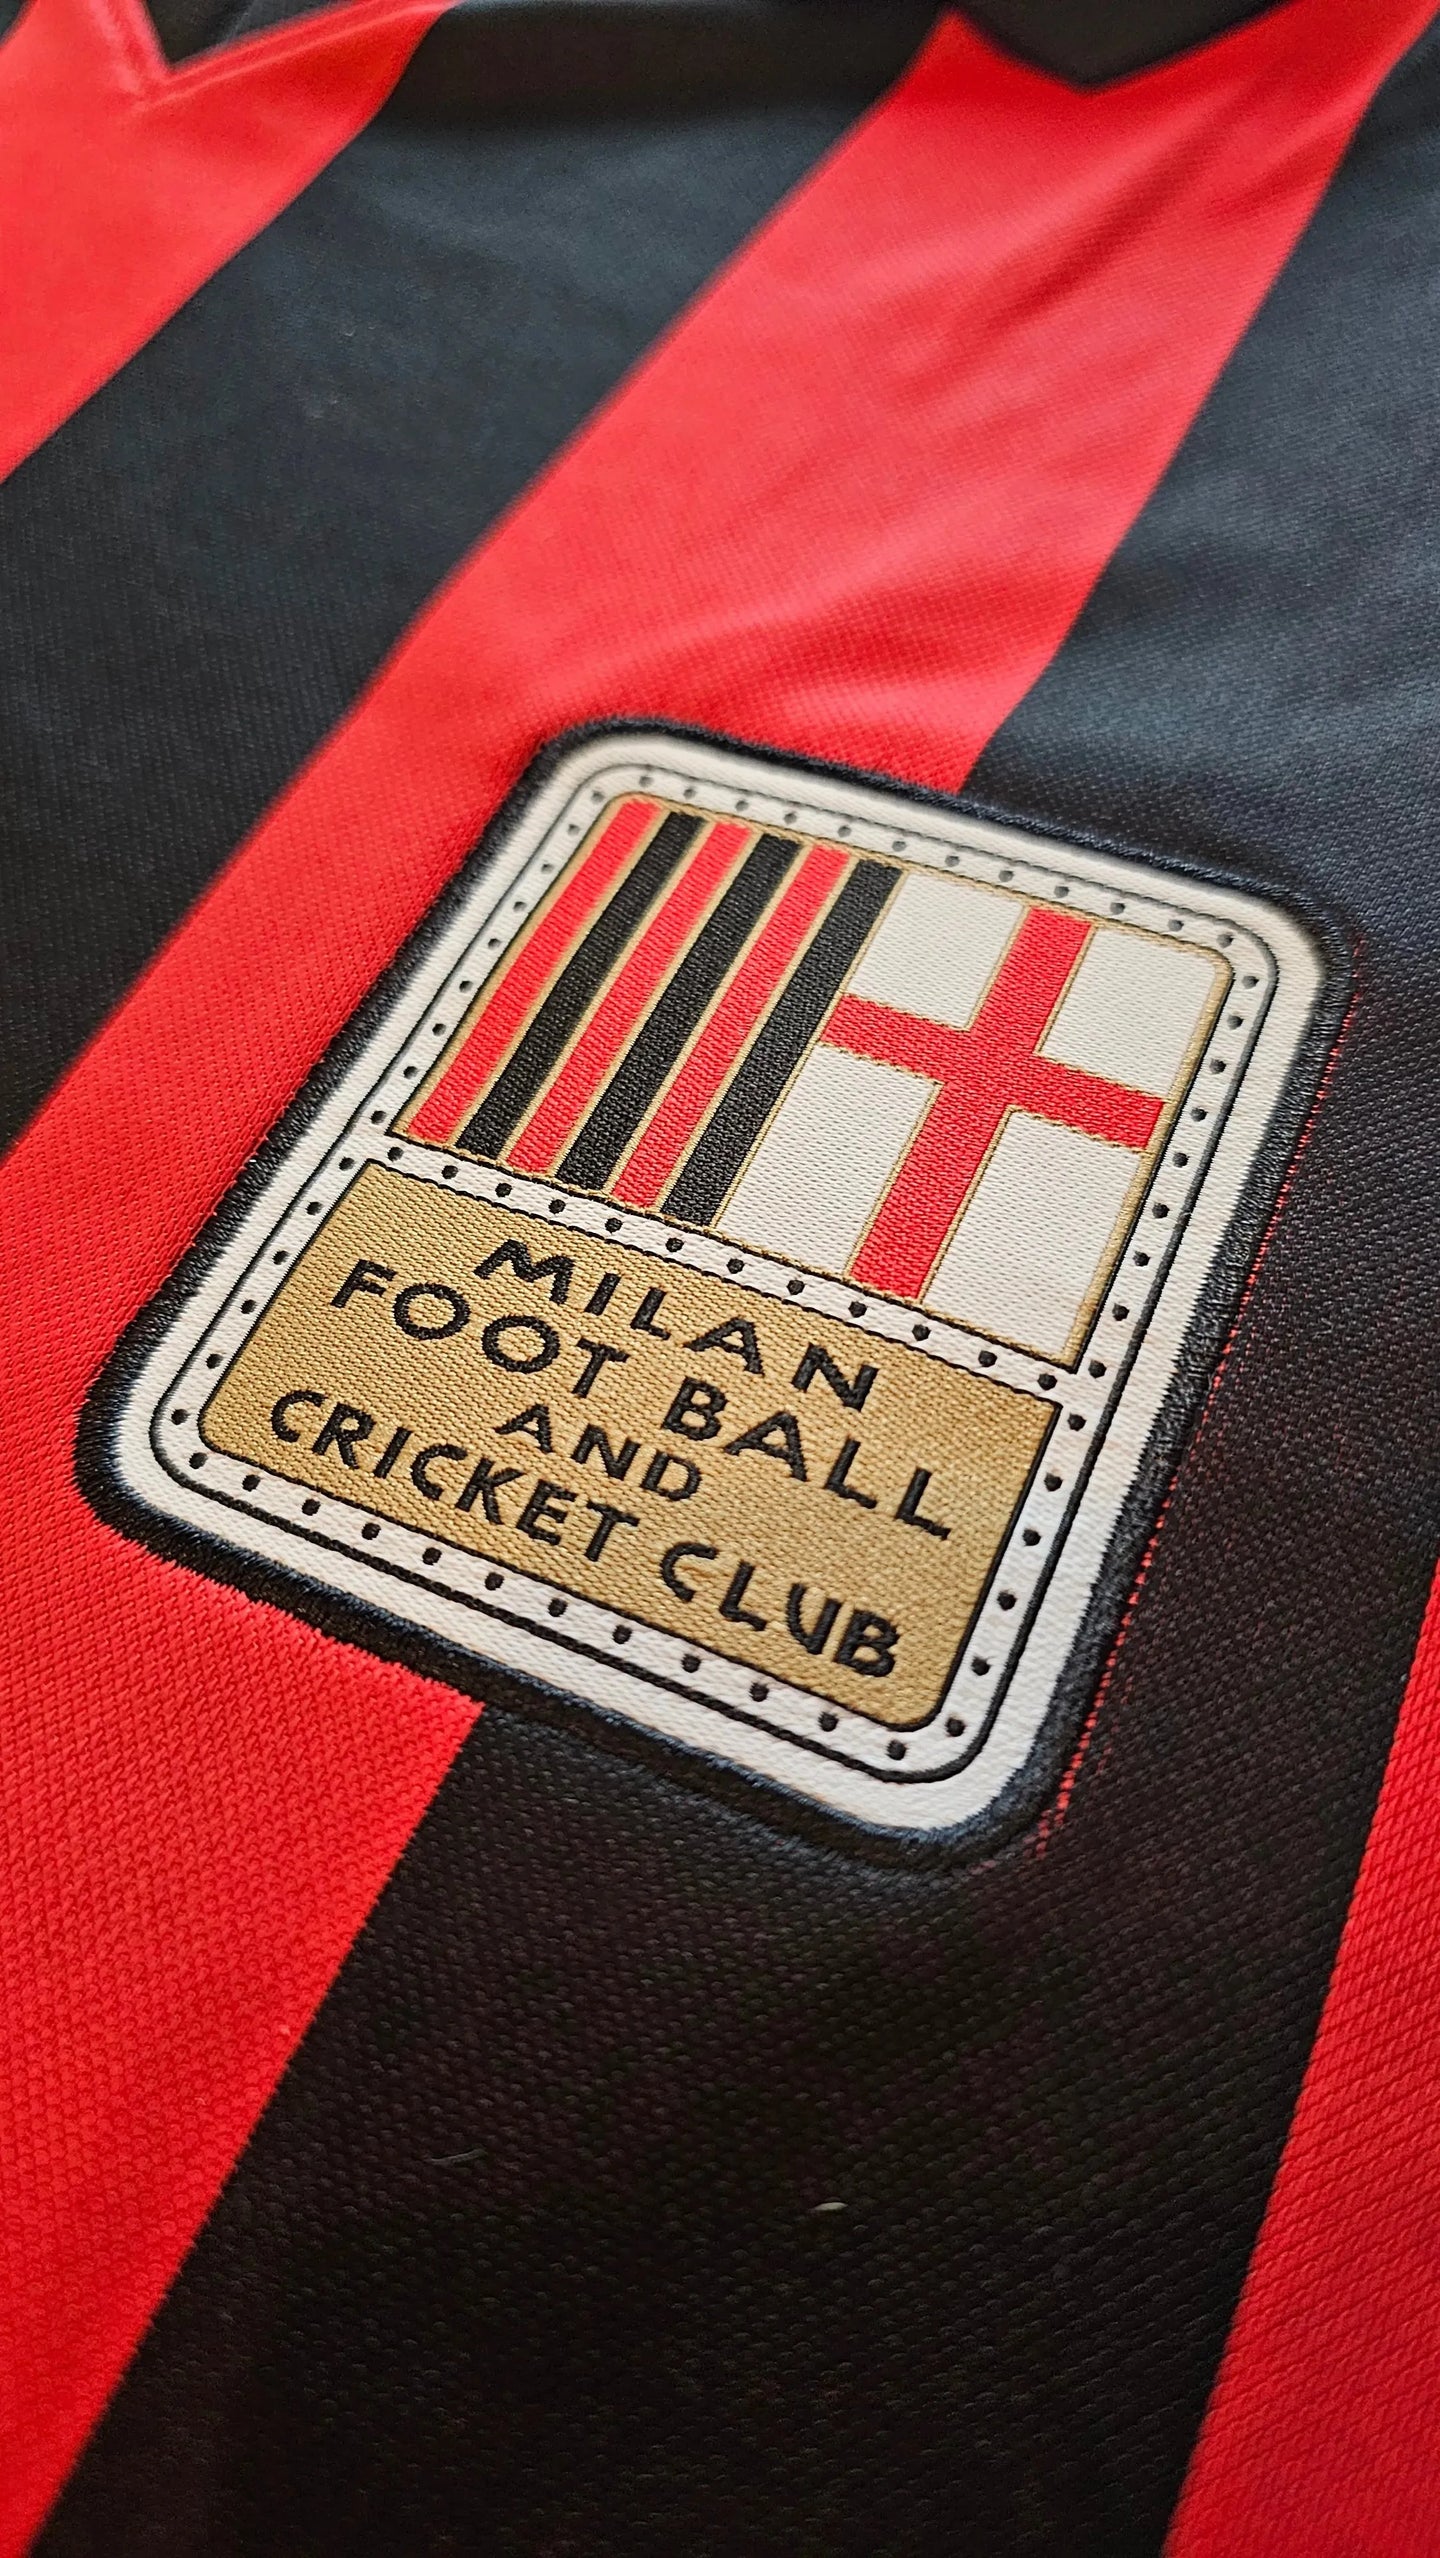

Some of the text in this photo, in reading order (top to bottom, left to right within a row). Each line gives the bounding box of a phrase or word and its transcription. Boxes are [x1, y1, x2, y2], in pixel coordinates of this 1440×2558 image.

[329, 1258, 953, 1540] FOOT BALL
[473, 1238, 880, 1414] MILAN
[270, 1390, 902, 1678] CRICKET CLUB
[495, 1404, 701, 1503] AND
